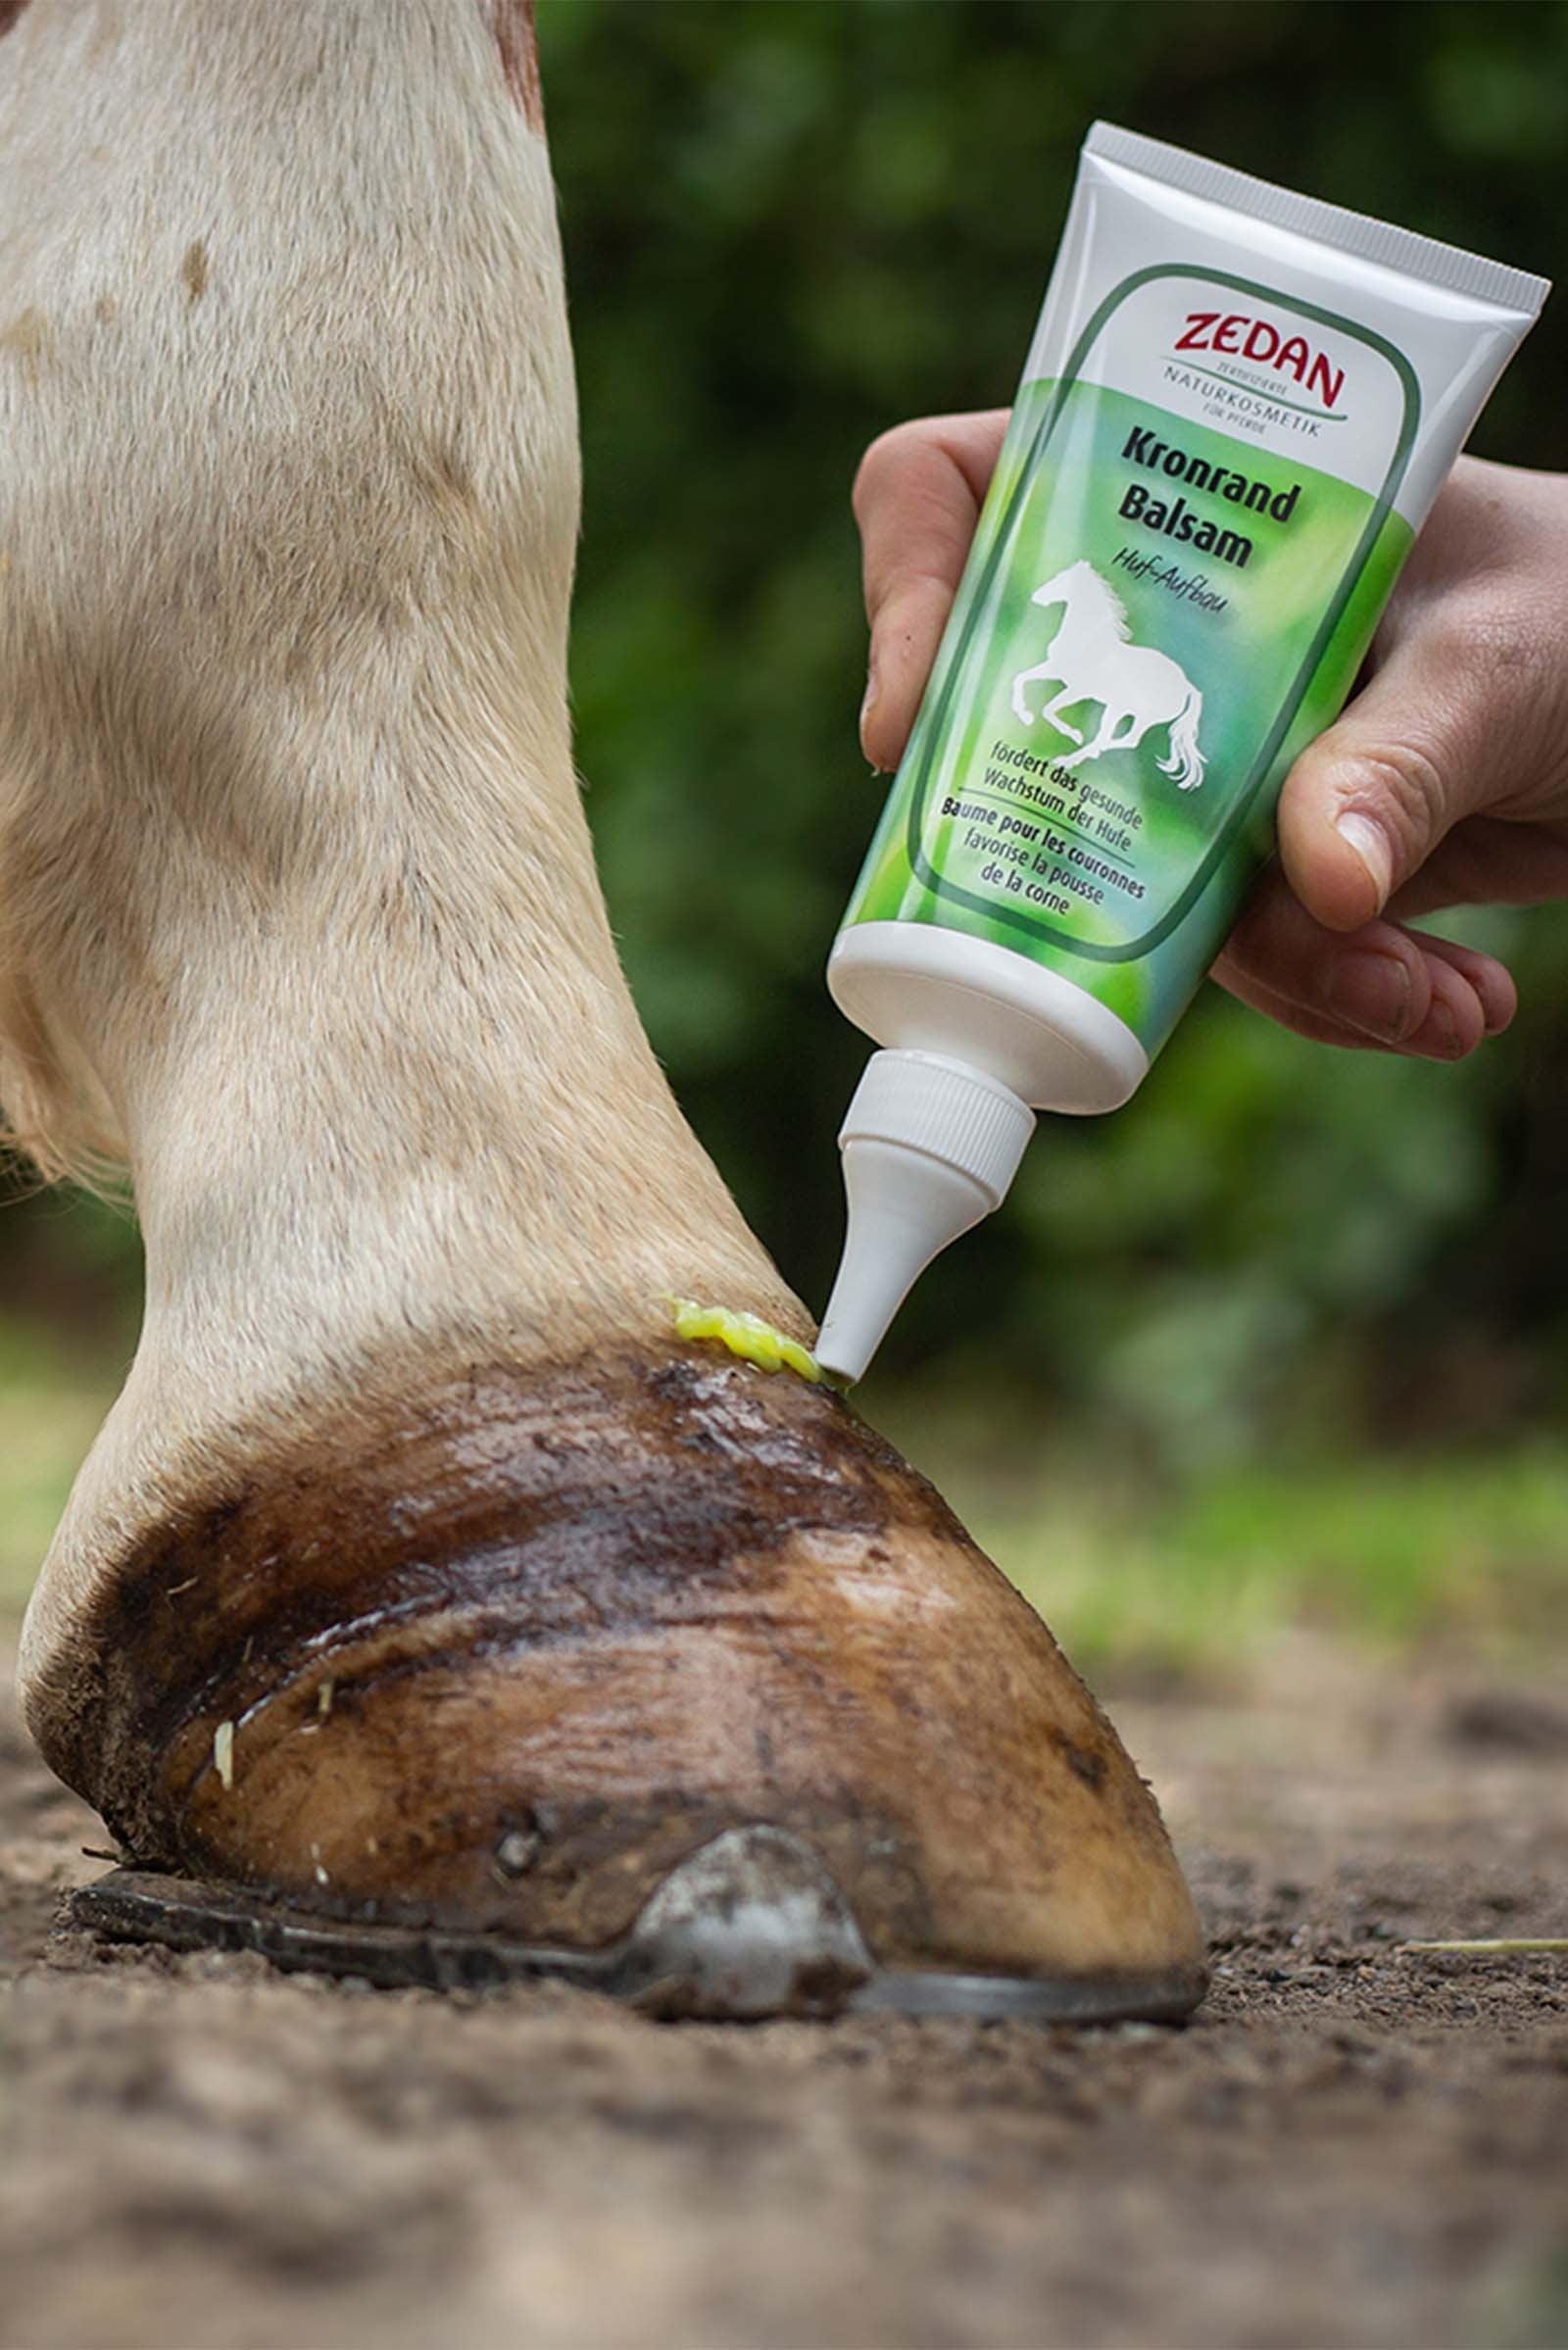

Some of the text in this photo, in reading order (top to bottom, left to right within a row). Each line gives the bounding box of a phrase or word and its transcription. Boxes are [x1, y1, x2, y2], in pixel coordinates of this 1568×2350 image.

[1164, 367, 1322, 436] NATURKOSMETIK
[1174, 314, 1345, 408] ZEDAN
[1122, 425, 1302, 523] Kronrand
[1118, 484, 1253, 568] Balsam
[1111, 547, 1228, 613] Huf-Aufbau
[983, 767, 1132, 852] Wachstum der Hufe
[1050, 766, 1078, 792] das
[1080, 785, 1143, 830] gesunde
[941, 797, 1147, 900] Baume pour les couronnes
[964, 826, 1105, 905] favorise la pousse
[981, 862, 1071, 915] de la corne
